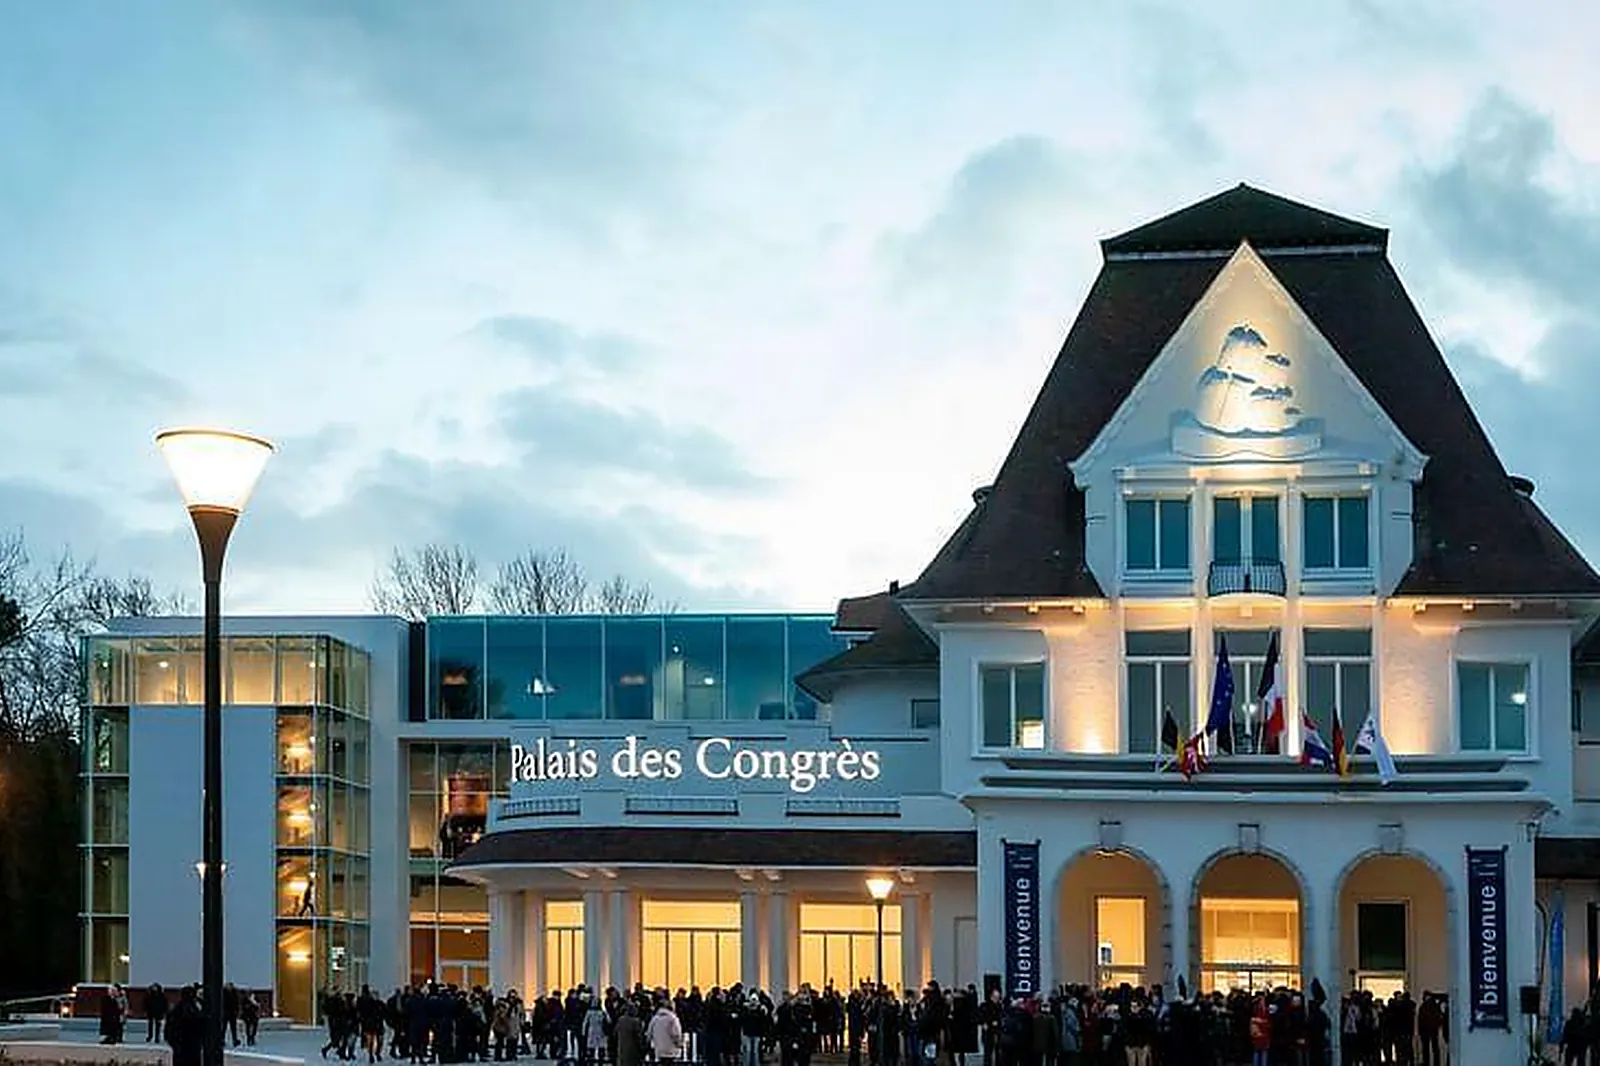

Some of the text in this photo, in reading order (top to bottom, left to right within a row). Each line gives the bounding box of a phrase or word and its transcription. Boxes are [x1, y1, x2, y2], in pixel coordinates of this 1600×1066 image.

[511, 736, 880, 792] Palais des Congrès
[1014, 877, 1032, 993] bienvenue
[1479, 885, 1498, 1006] bienvenue
